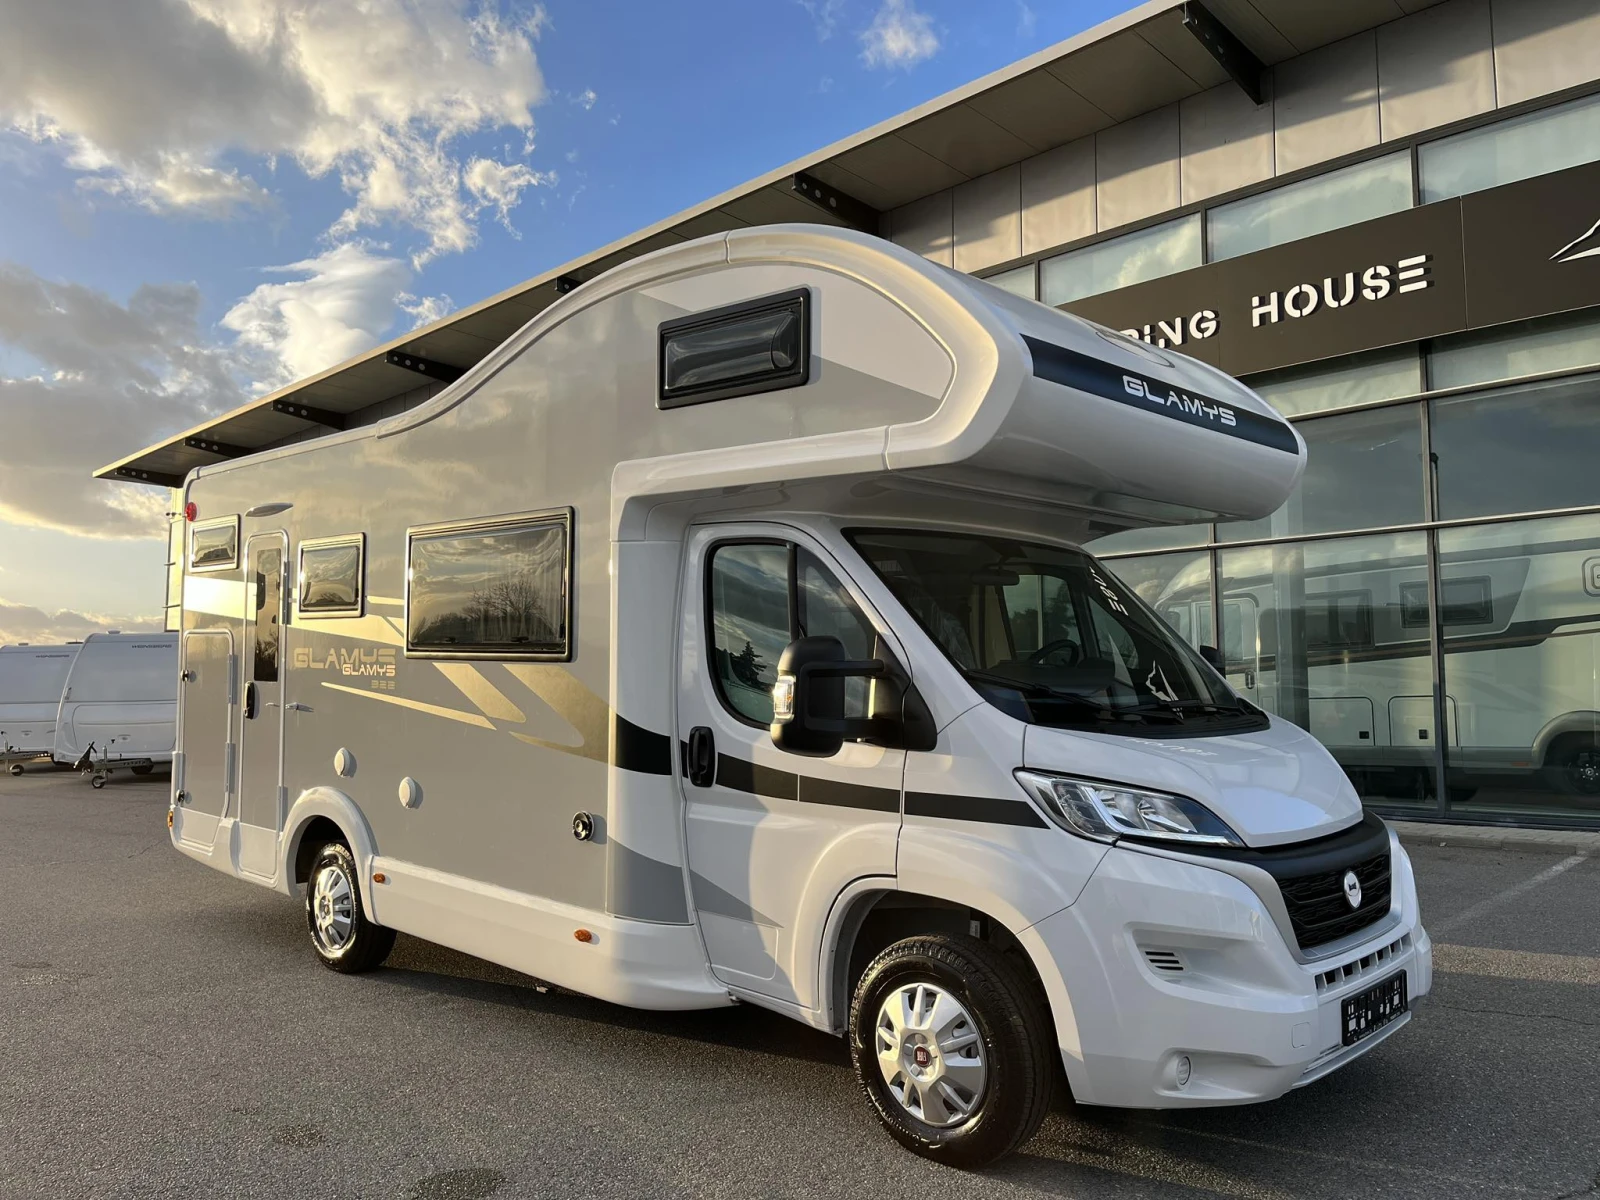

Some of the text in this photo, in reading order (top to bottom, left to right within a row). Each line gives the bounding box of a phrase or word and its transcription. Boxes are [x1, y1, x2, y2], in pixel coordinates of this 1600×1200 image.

[1119, 254, 1429, 349] ING HOUSE
[1121, 374, 1237, 427] GLAMYS
[342, 664, 396, 677] GLAMYS
